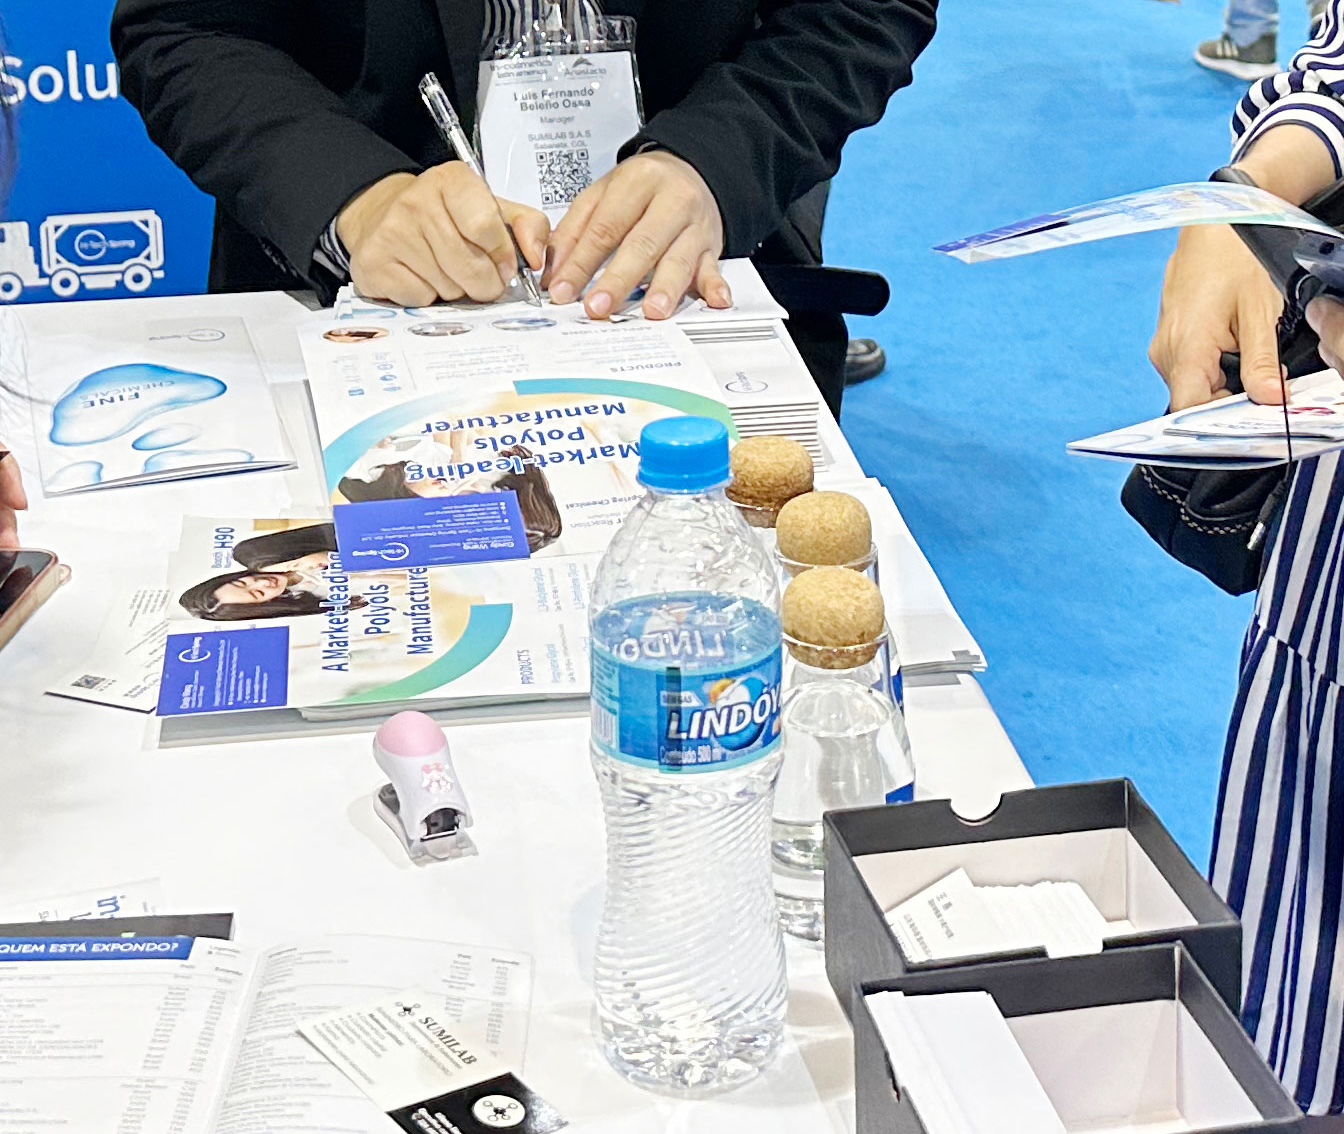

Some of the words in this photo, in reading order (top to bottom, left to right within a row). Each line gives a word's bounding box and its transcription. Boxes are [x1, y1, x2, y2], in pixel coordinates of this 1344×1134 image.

[421, 402, 626, 435] Manufacturer
[474, 426, 585, 452] Polyols
[214, 527, 235, 549] H90
[362, 584, 397, 635] Polyols
[49, 941, 87, 953] ESTÁ
[91, 941, 178, 953] EXPONDO?
[418, 1016, 477, 1065] SUMILAB
